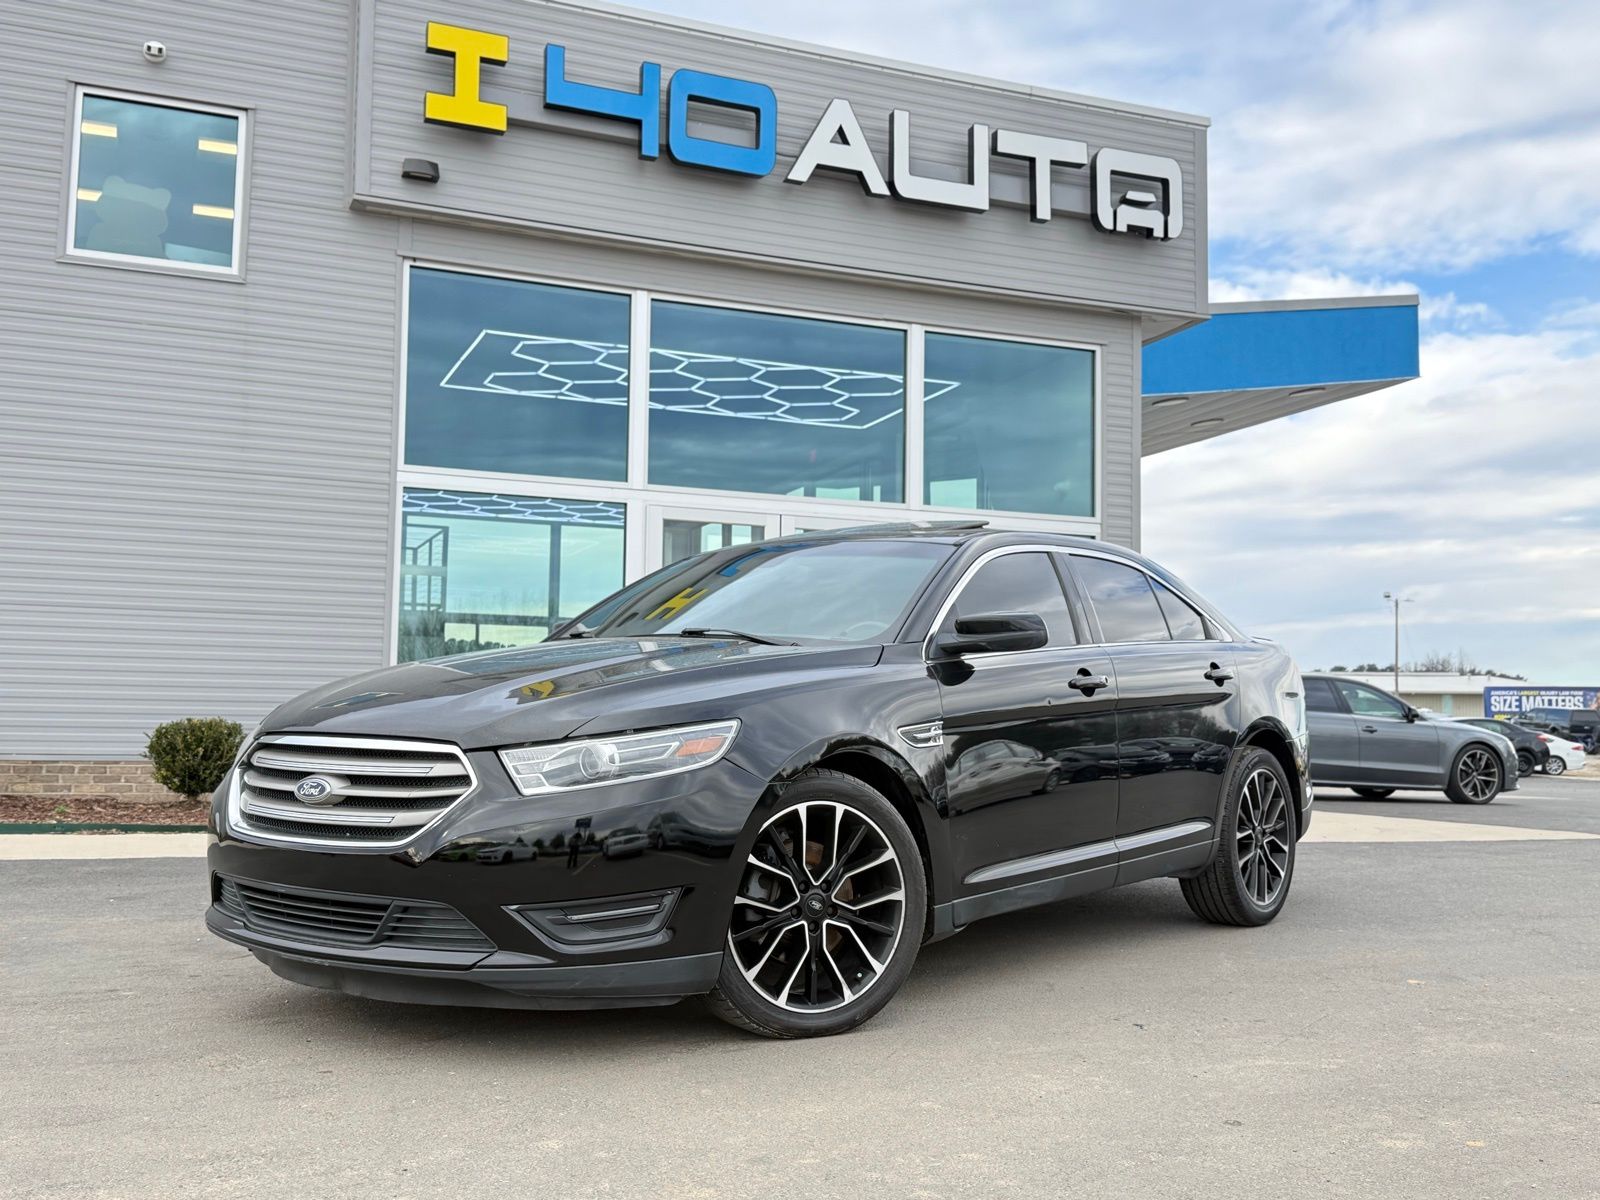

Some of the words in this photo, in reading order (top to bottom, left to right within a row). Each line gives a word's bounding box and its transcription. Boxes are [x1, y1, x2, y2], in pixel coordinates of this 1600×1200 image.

[785, 98, 1182, 240] AUTO
[1490, 696, 1519, 712] SIZE
[1522, 696, 1584, 712] MATTERS
[300, 781, 322, 796] Ford
